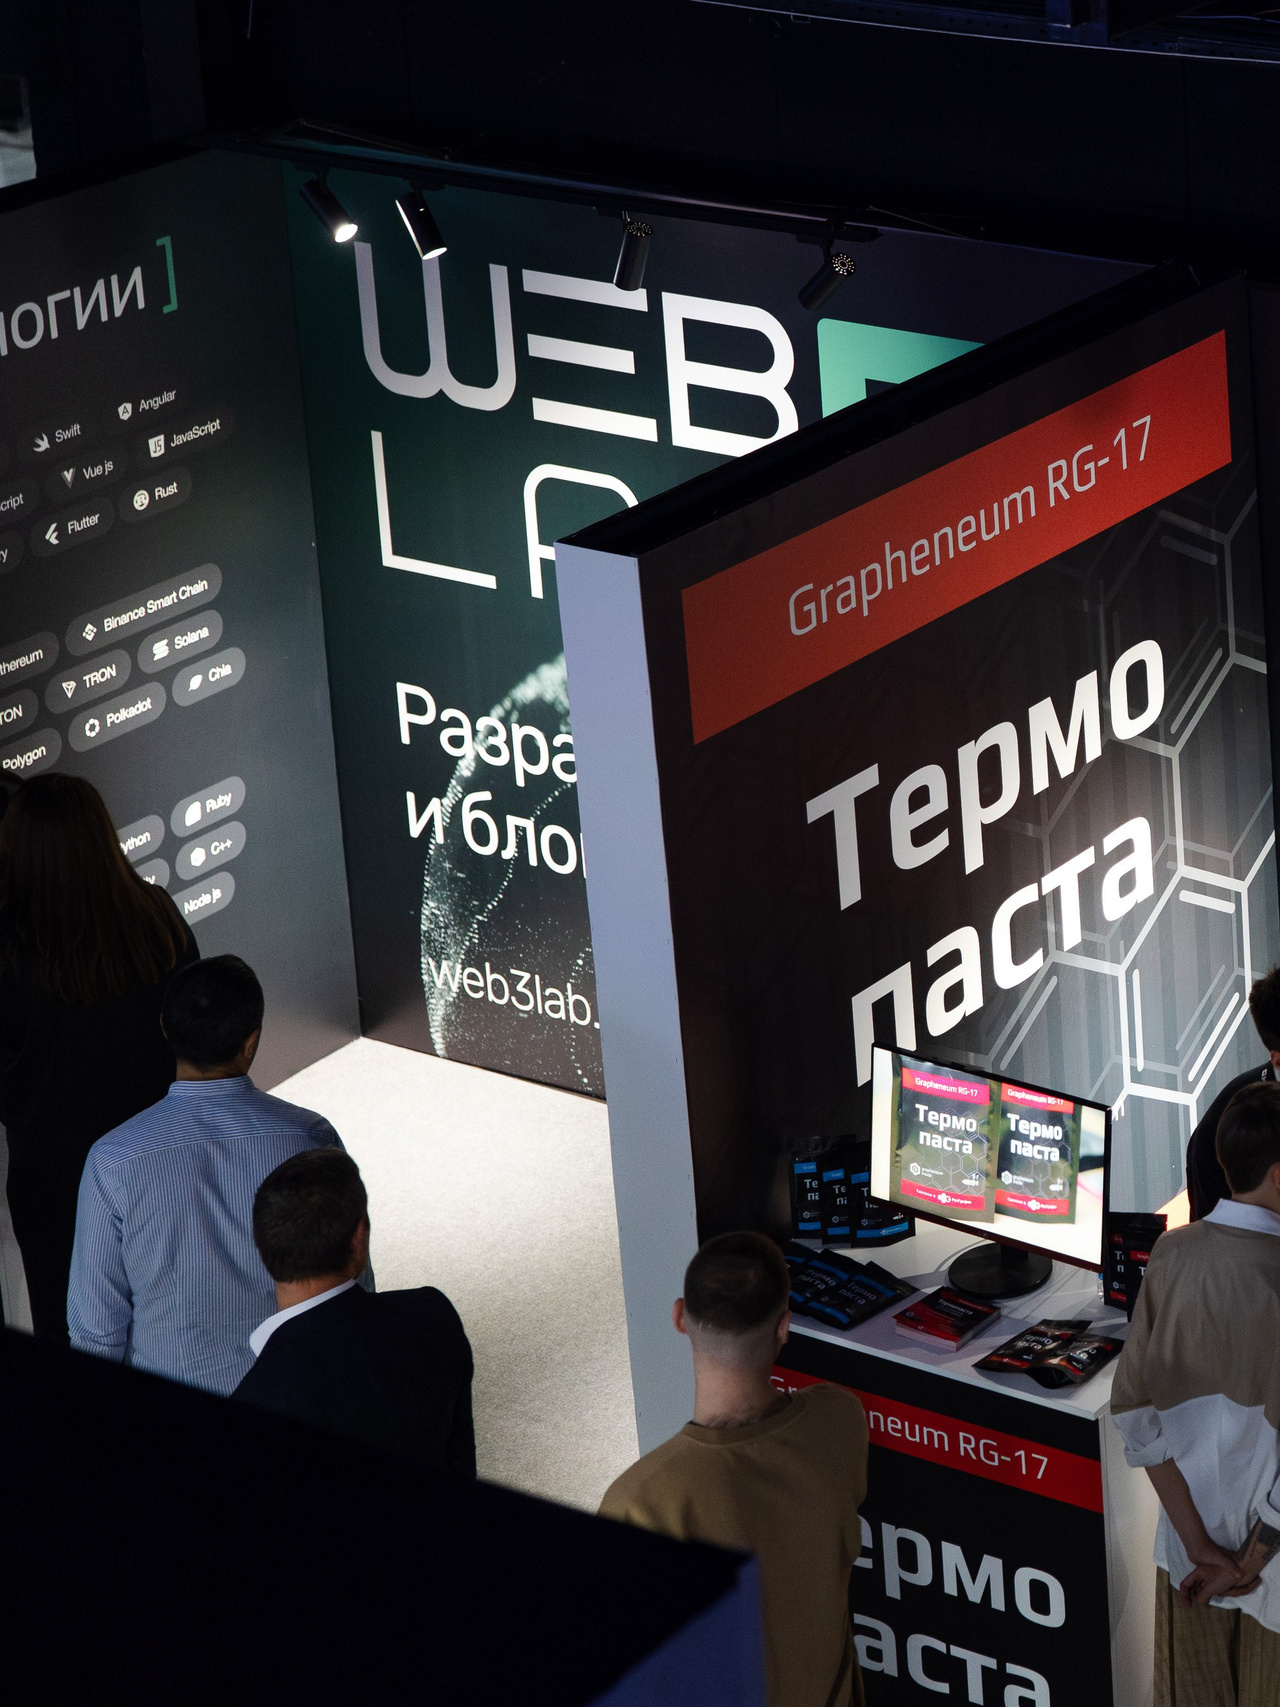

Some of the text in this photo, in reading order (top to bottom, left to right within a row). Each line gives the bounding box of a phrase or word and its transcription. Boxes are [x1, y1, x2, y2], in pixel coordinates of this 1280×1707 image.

[139, 390, 177, 412] Angular
[55, 424, 81, 442] Swift
[170, 419, 221, 447] JavaScript
[0, 493, 24, 511] cript
[155, 482, 178, 500] Rust
[67, 513, 100, 534] Flutter
[787, 414, 1153, 638] Grapheneum RG-17
[103, 579, 208, 632] Binance Smart Chain
[174, 626, 209, 650] Solana
[0, 648, 43, 676] thereum
[208, 662, 232, 682] Chia
[83, 664, 117, 688] TRON
[106, 697, 152, 727] Polkadot
[2, 745, 46, 770] Polygon
[805, 639, 1166, 911] Термо
[206, 792, 232, 813] Ruby
[120, 832, 151, 856] ython
[406, 790, 588, 879] и бло
[184, 893, 212, 915] Node
[850, 815, 1156, 1089] паста
[915, 1077, 978, 1097] Grapheneum RG-17
[1007, 1088, 1047, 1105] Grapheneum
[915, 1103, 977, 1132] Термо
[1007, 1112, 1063, 1142] Термо
[919, 1130, 973, 1155] паста
[1010, 1138, 1060, 1163] паста
[806, 1268, 837, 1287] Термо
[839, 1288, 866, 1305] паста
[847, 1281, 877, 1300] Термо
[959, 1432, 1049, 1480] RG-17
[853, 1612, 1052, 1707] аста
